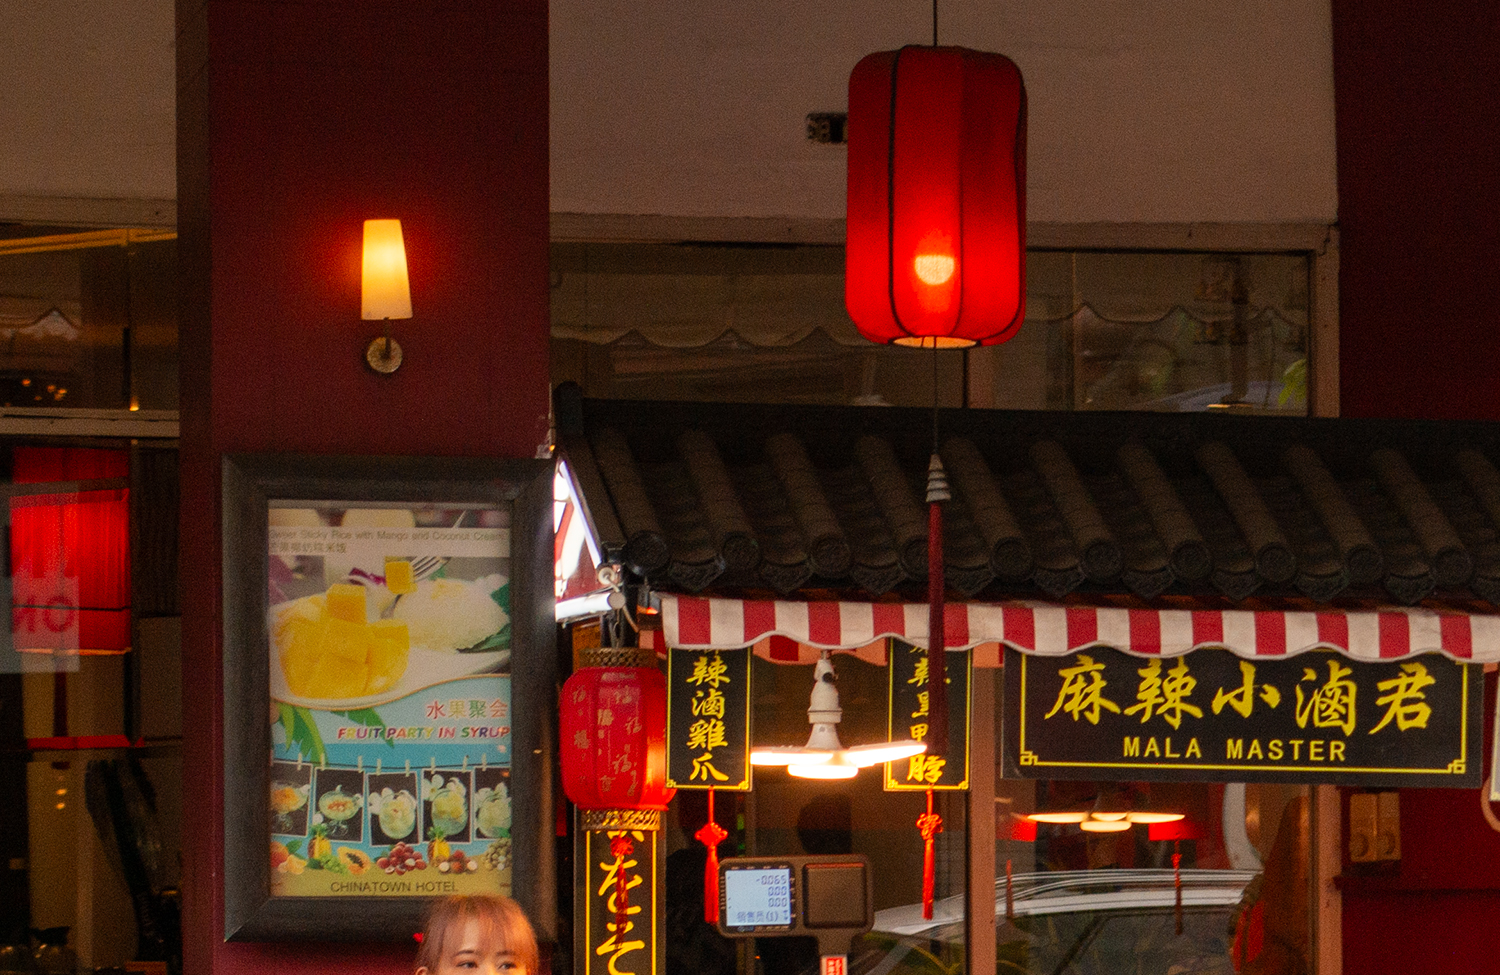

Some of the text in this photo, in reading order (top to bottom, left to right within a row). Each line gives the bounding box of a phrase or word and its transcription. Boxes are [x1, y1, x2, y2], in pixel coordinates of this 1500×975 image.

[377, 530, 408, 542] Mango
[426, 699, 508, 719] 水果聚会
[686, 649, 731, 781] 辣滷雞爪
[336, 726, 511, 740] FRUIT PARTY IN SYRUP
[1122, 736, 1347, 763] MALA MASTER
[330, 880, 459, 893] CHINATOWN HOTEL
